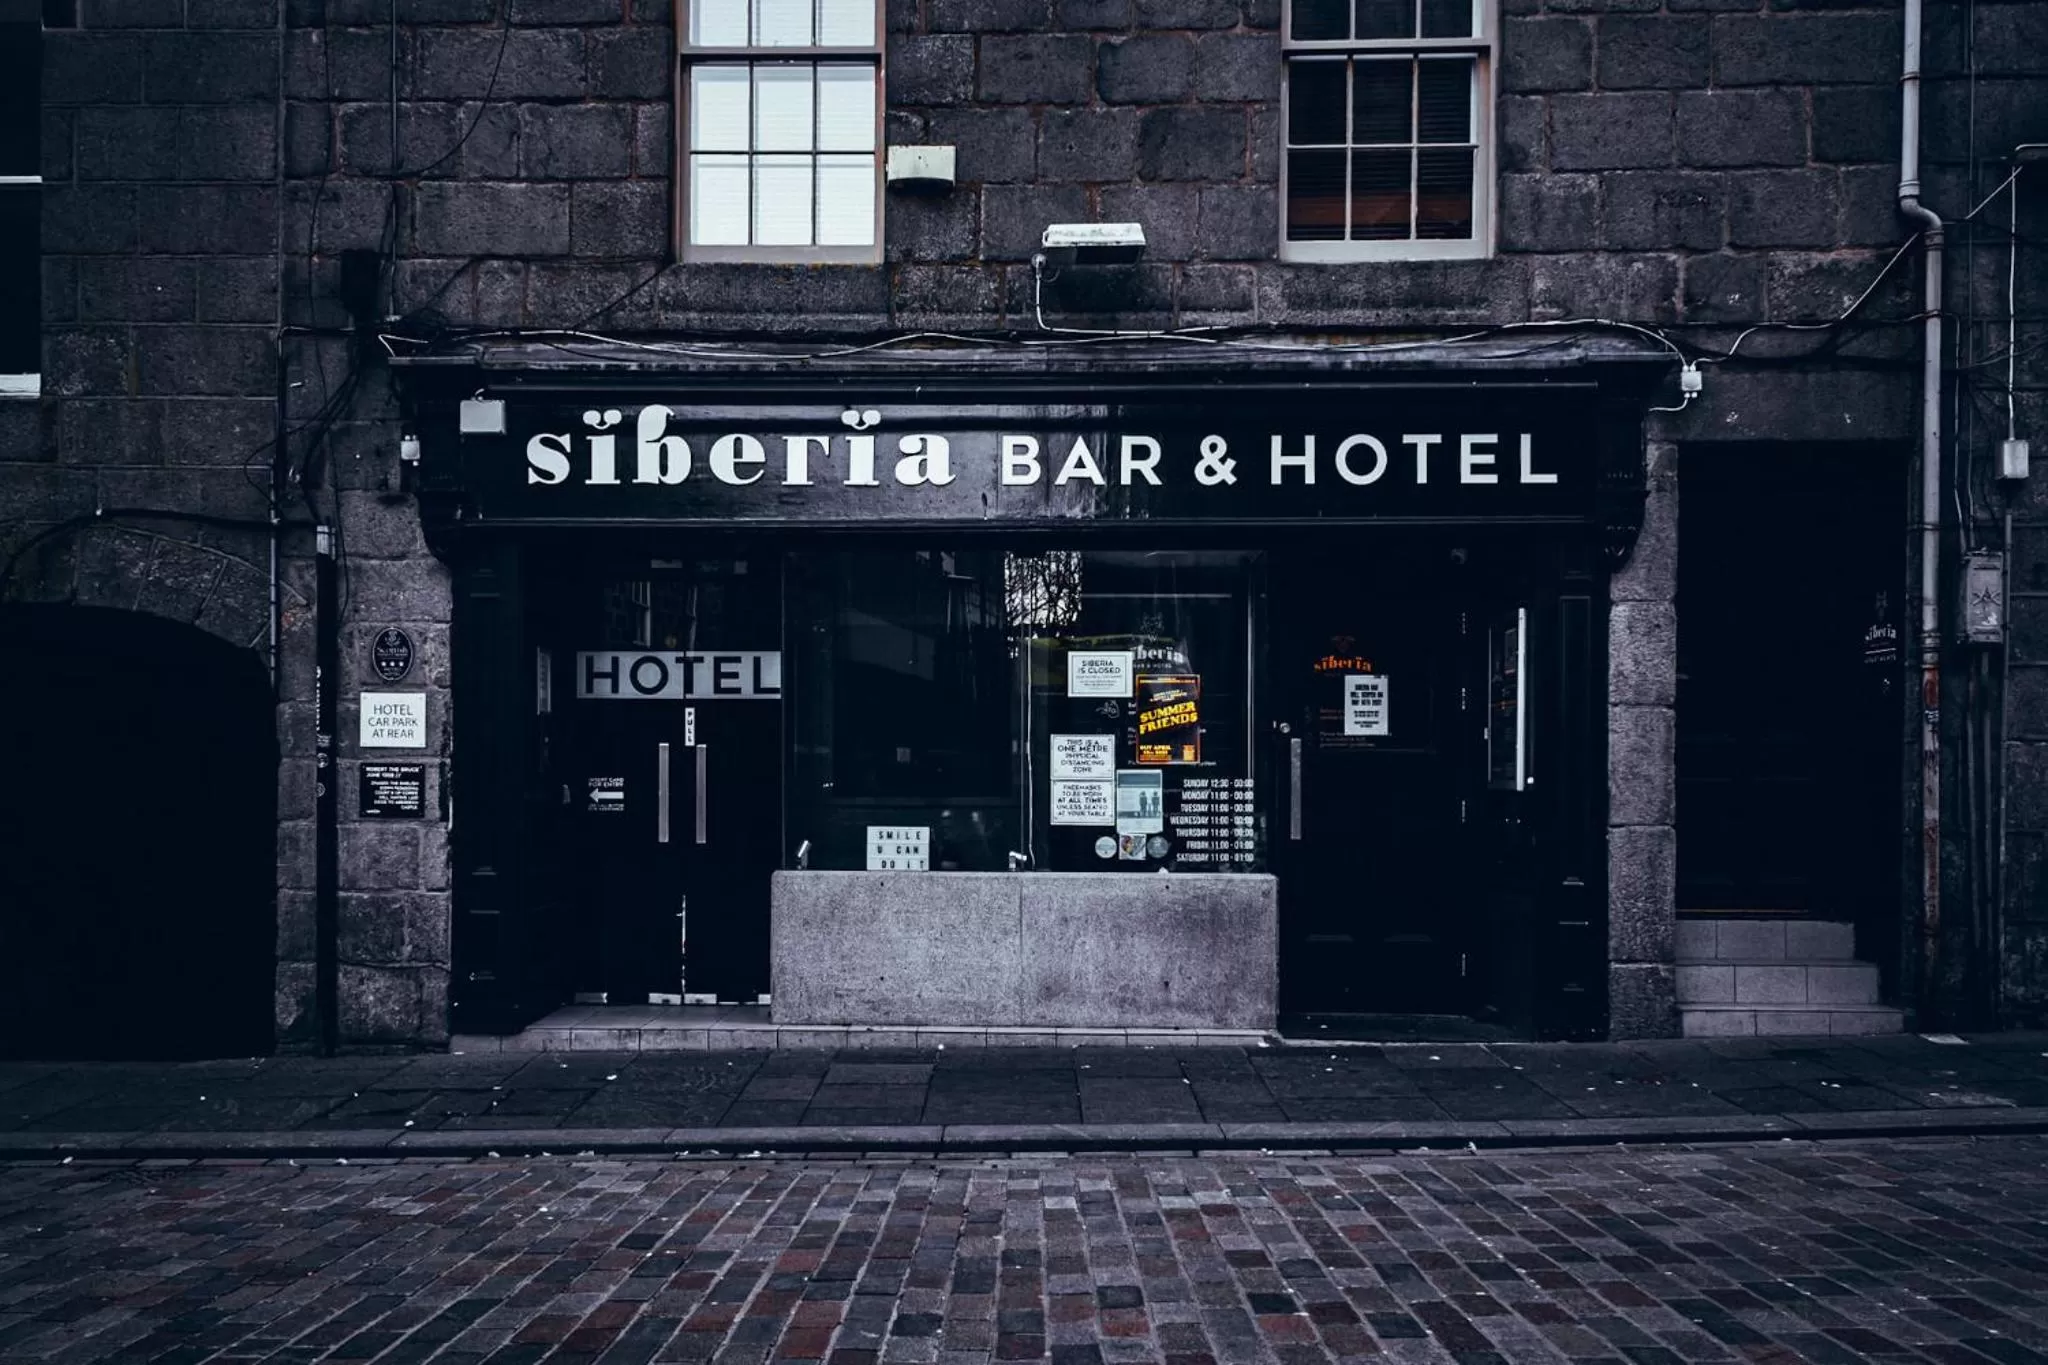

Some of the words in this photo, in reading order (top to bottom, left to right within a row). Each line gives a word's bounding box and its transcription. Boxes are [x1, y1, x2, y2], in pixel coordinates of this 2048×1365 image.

[1000, 435, 1163, 486] BAR
[1194, 434, 1238, 486] &
[1271, 433, 1558, 485] HOTEL
[585, 655, 781, 695] HOTEL
[374, 704, 414, 715] HOTEL
[1139, 701, 1196, 723] SUMMER
[368, 717, 390, 727] CAR
[392, 717, 418, 727] PARK
[1139, 712, 1198, 735] FRIENDS
[372, 729, 384, 738] AT
[387, 729, 415, 738] REAR
[1183, 779, 1208, 787] SUNDAY
[1182, 791, 1208, 800] MONDAY
[1180, 803, 1208, 812] TUESDAY
[1170, 816, 1208, 824] WEDNESDAY
[879, 831, 921, 840] SMILE
[1176, 828, 1208, 837] THURSDAY
[1186, 840, 1208, 849] FRIDAY
[896, 845, 919, 854] CAN
[1176, 853, 1208, 861] SATURDAY
[881, 860, 895, 869] DO
